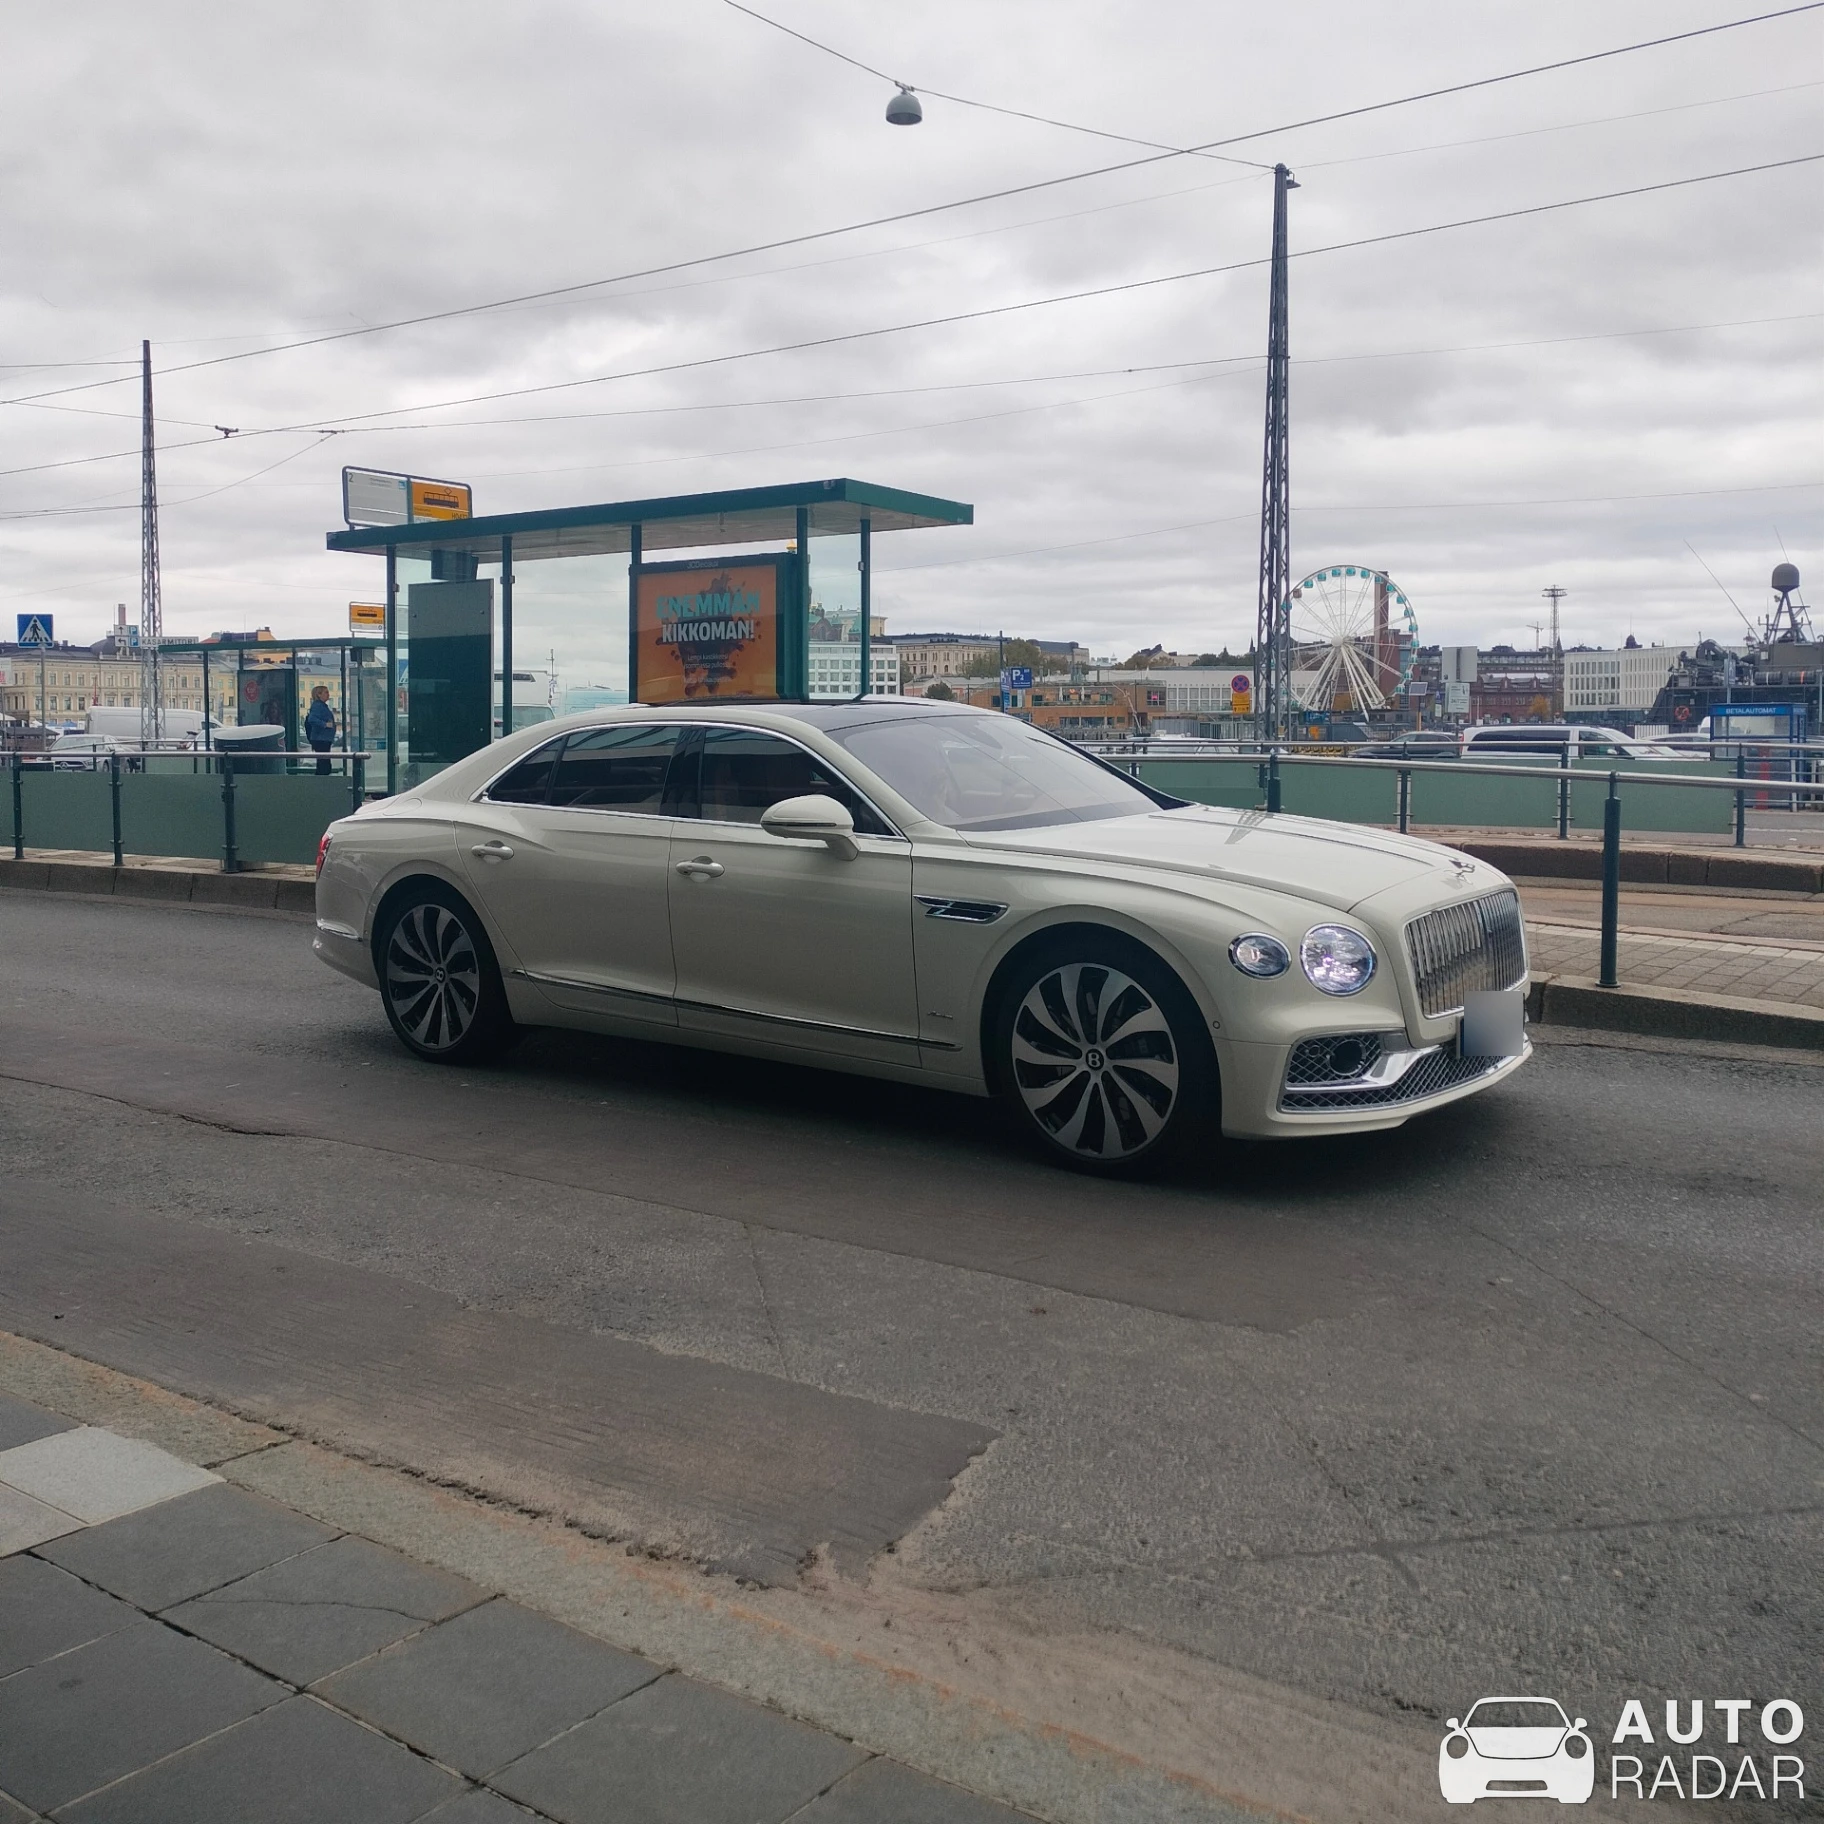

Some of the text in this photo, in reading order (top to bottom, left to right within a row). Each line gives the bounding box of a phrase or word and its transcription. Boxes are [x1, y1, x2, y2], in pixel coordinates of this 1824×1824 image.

[349, 473, 354, 482] 2
[656, 588, 761, 619] ENEMMÄN
[662, 620, 755, 643] KIKKOMAN!
[142, 638, 196, 646] KASARMITORI
[1088, 1053, 1101, 1067] B
